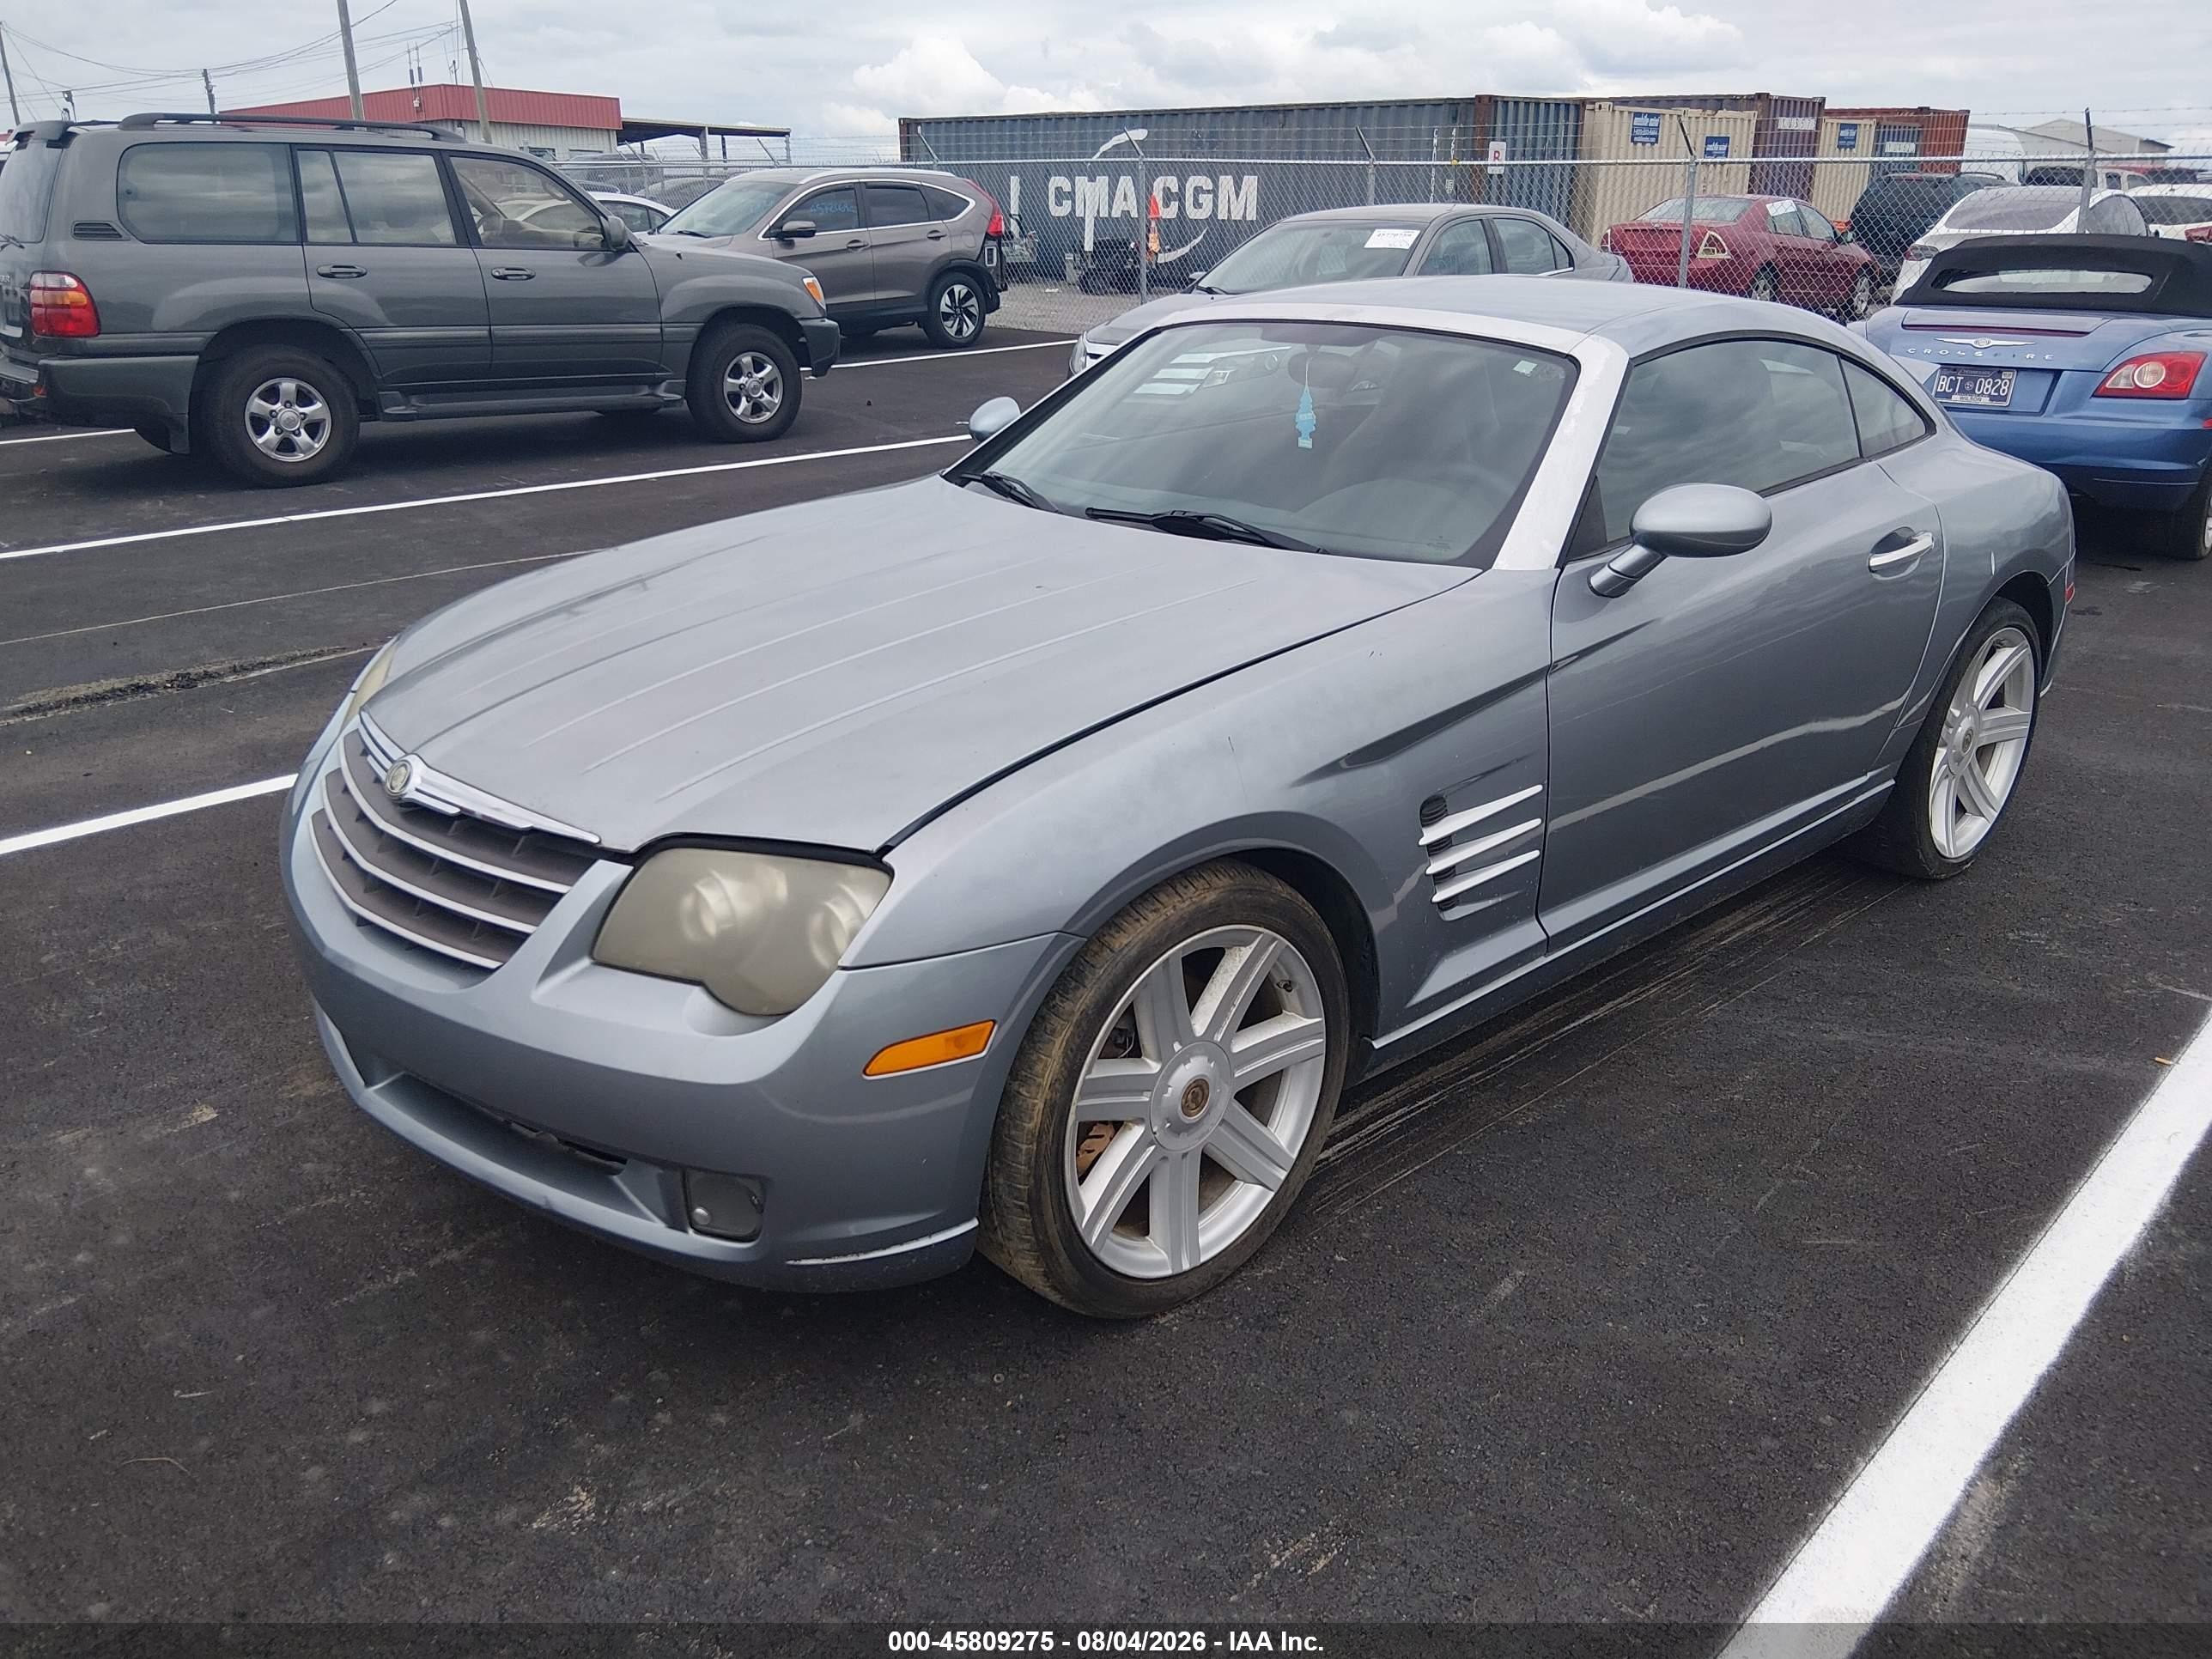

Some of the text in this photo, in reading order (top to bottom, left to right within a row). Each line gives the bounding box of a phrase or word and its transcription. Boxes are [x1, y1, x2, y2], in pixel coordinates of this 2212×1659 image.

[1048, 175, 1259, 221] CMA CGM
[1936, 375, 2010, 396] BCT 0828
